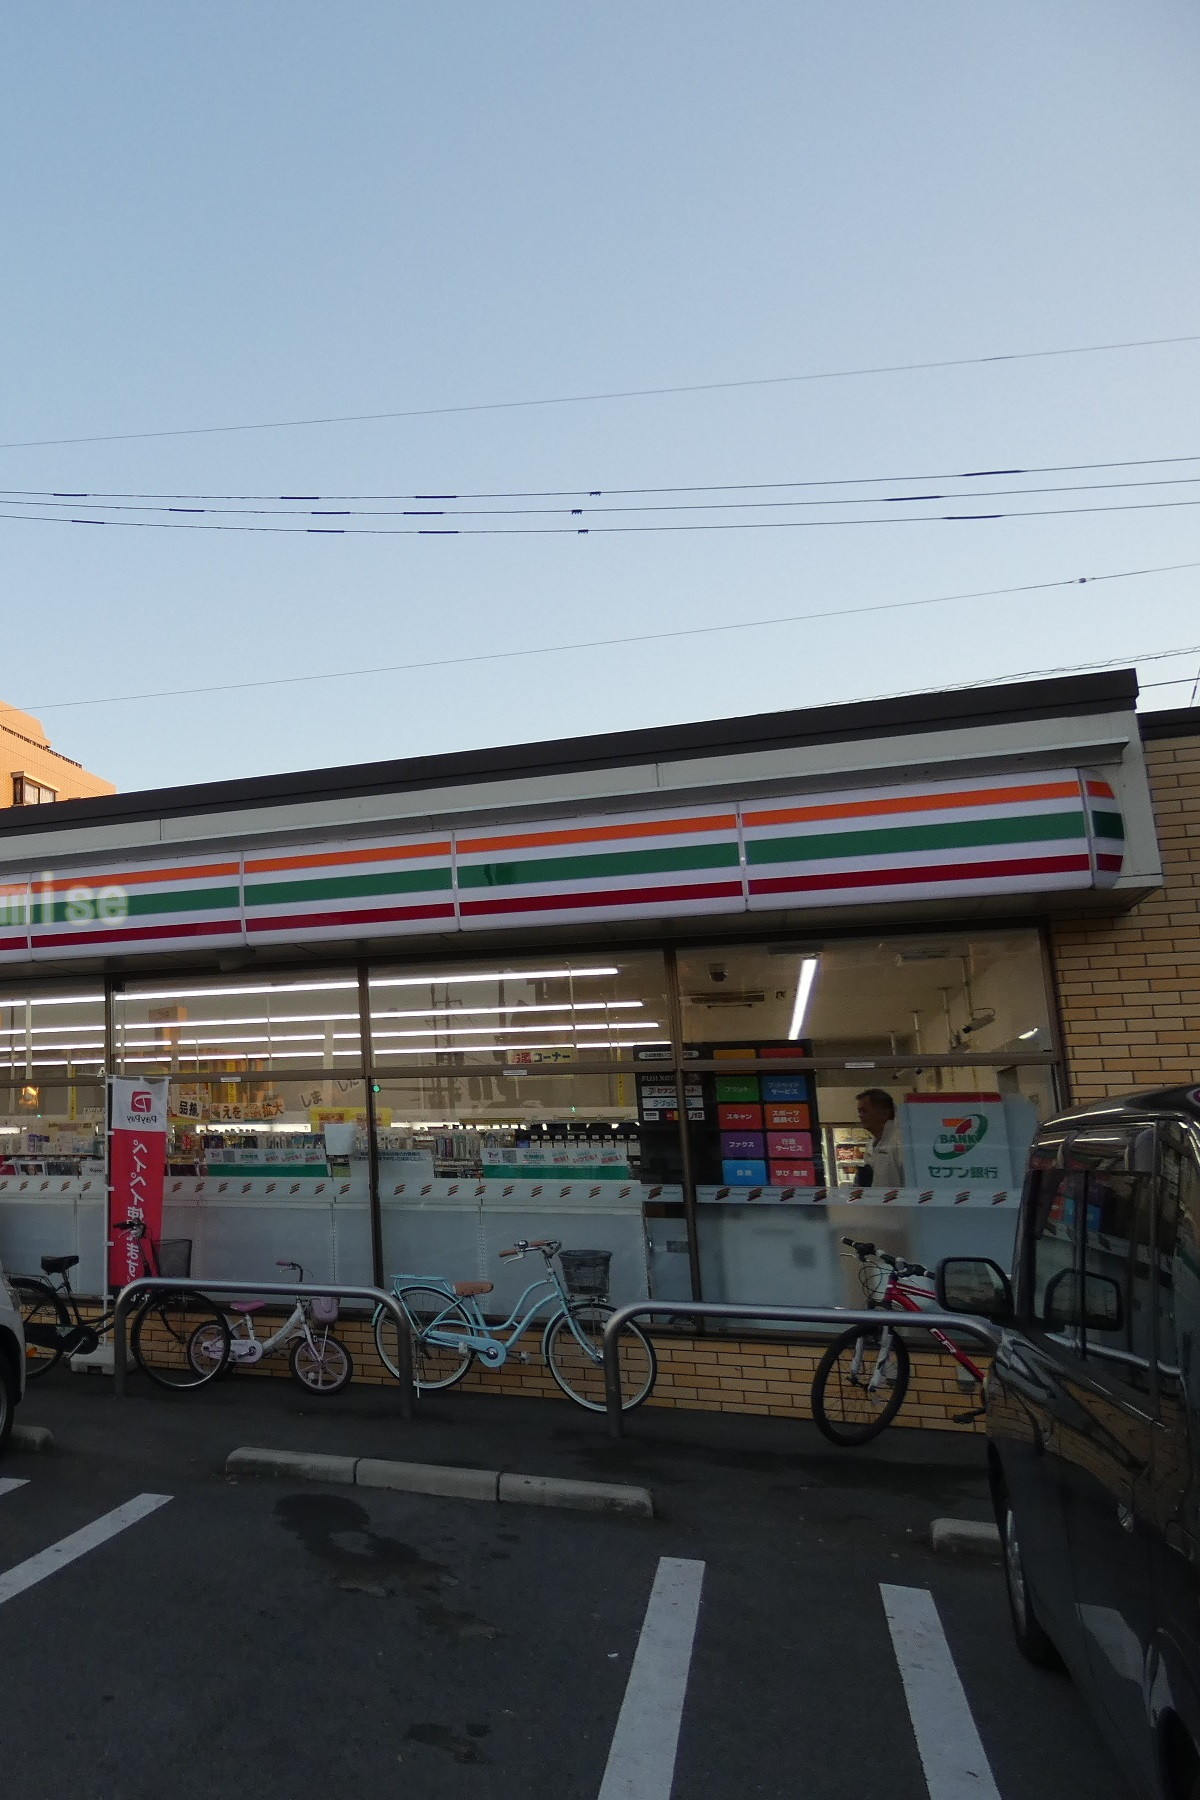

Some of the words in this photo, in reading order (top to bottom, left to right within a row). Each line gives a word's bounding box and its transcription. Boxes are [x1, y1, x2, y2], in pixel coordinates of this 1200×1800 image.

[928, 1165, 998, 1179] セブン銀行
